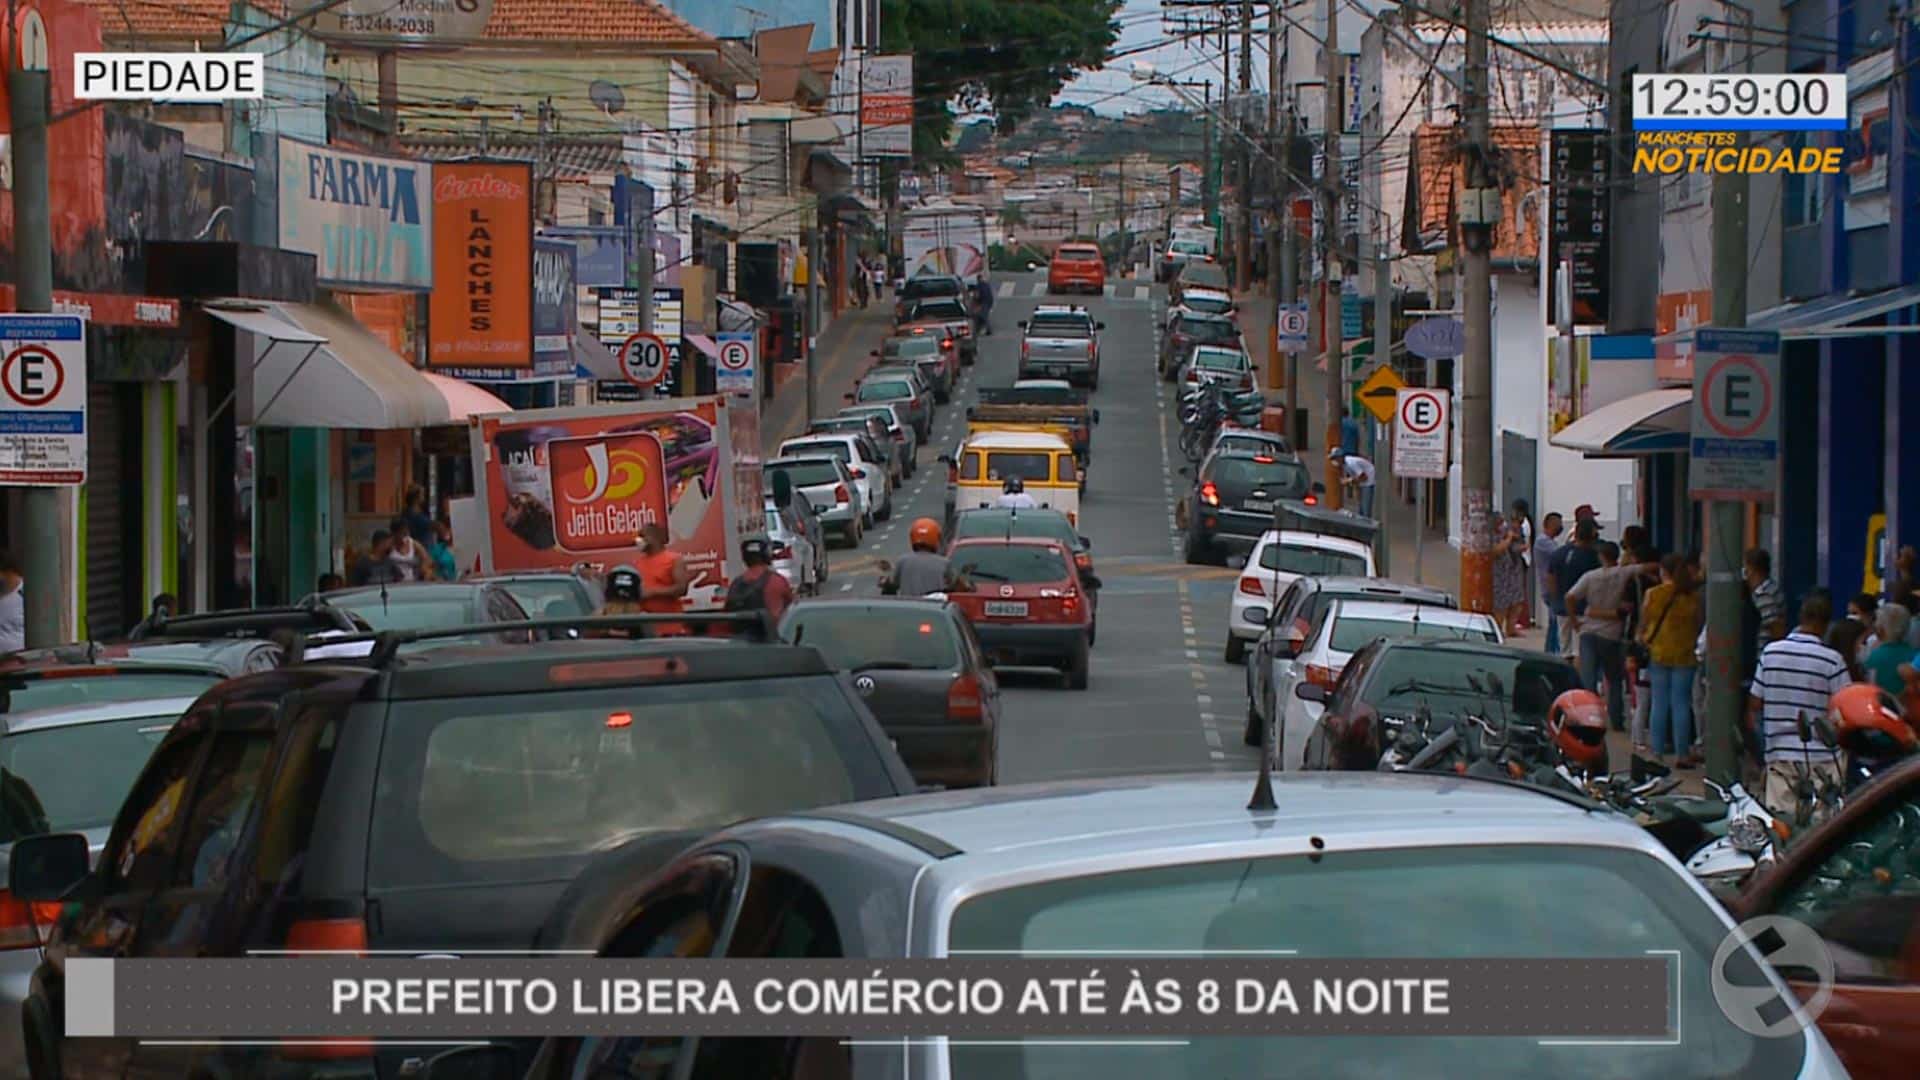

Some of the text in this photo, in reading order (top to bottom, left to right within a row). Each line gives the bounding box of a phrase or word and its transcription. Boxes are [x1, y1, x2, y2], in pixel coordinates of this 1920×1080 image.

[307, 152, 421, 225] FARMA
[434, 173, 523, 202] Center
[467, 208, 493, 332] LANCHES
[1287, 316, 1298, 330] E
[629, 342, 661, 368] 30
[728, 347, 740, 364] E
[20, 355, 45, 396] E
[1725, 375, 1751, 417] E
[1414, 401, 1430, 425] E
[566, 501, 657, 537] Jeito Gelado
